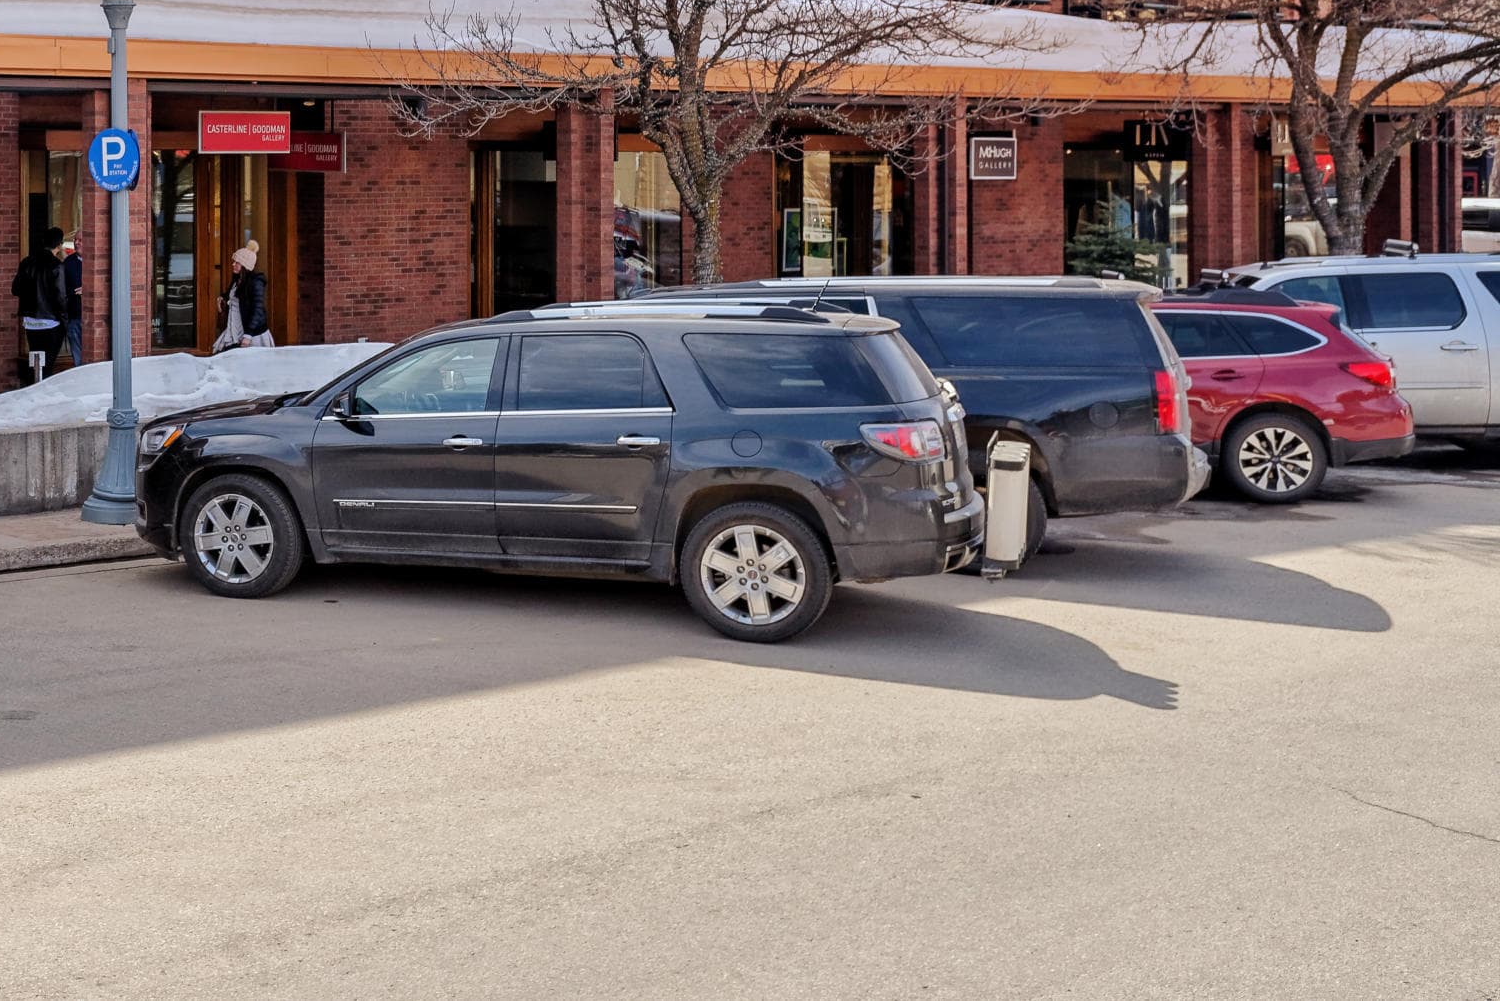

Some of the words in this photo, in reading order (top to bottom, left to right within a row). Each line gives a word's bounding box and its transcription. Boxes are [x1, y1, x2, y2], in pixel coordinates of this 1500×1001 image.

[207, 124, 247, 134] CASTERLINE
[252, 125, 286, 134] GOODMAN
[261, 134, 285, 142] GALLERY
[307, 144, 338, 154] GOODMAN
[101, 136, 126, 177] P
